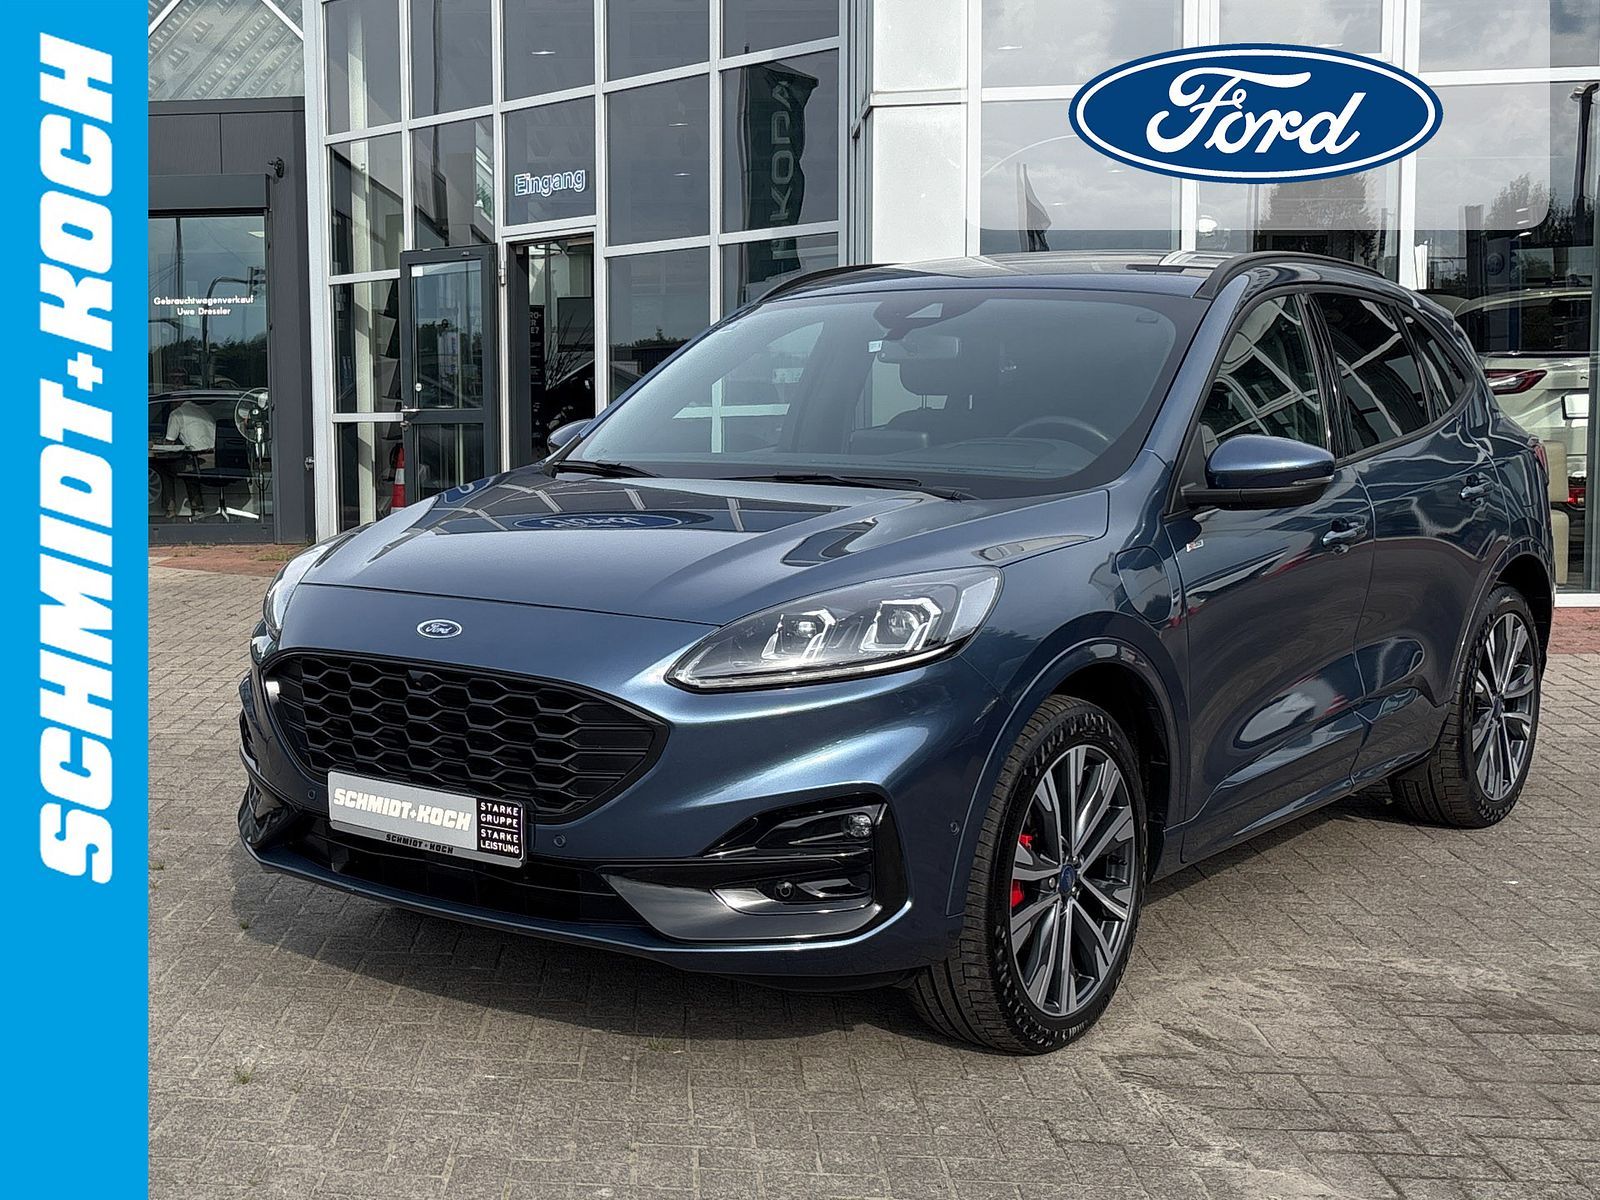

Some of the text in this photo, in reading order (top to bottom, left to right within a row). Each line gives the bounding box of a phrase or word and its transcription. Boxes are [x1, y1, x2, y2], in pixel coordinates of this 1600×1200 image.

[770, 80, 795, 250] KODA
[514, 169, 586, 197] Eingang
[153, 295, 254, 306] Gebrauchtwagenverkauf
[177, 306, 231, 316] Uwe Dressler
[333, 788, 473, 832] SCHMIDT+KOCH
[480, 802, 519, 817] STARKE
[480, 813, 519, 828] GRUPPE
[480, 829, 519, 843] STARKE
[385, 833, 423, 848] SCHMIDT
[429, 842, 454, 855] KOCH
[480, 840, 520, 855] LEISTUNG
